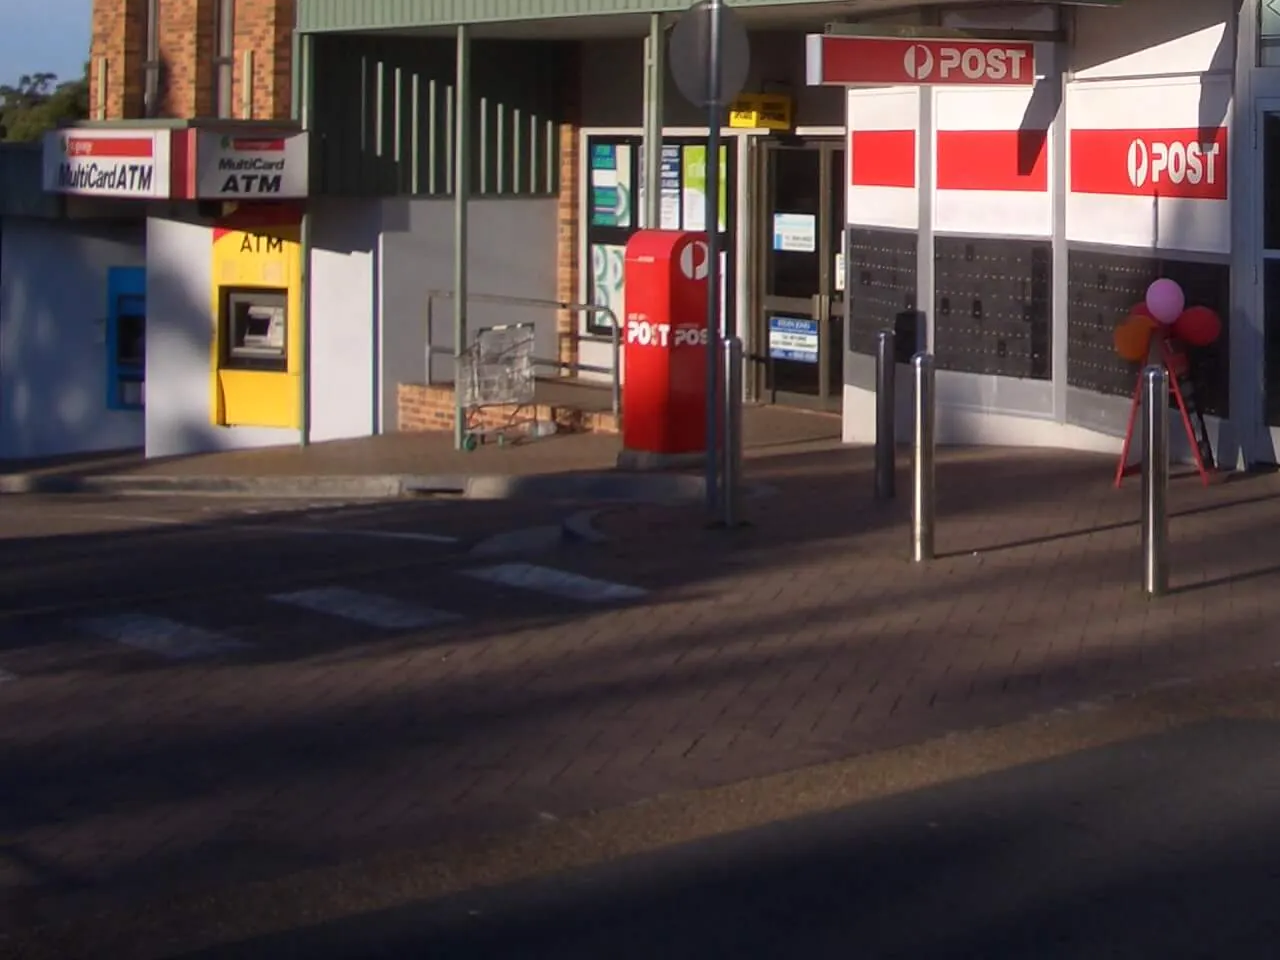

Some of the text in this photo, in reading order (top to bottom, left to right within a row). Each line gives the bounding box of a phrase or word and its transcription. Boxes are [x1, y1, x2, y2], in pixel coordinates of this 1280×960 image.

[940, 46, 1026, 79] POST
[219, 157, 285, 170] MultiCard
[1151, 141, 1220, 185] POST
[59, 162, 153, 191] MultiCard ATM
[220, 174, 282, 193] ATM
[240, 232, 284, 254] ATM
[627, 320, 671, 348] POST
[674, 327, 720, 347] POS
